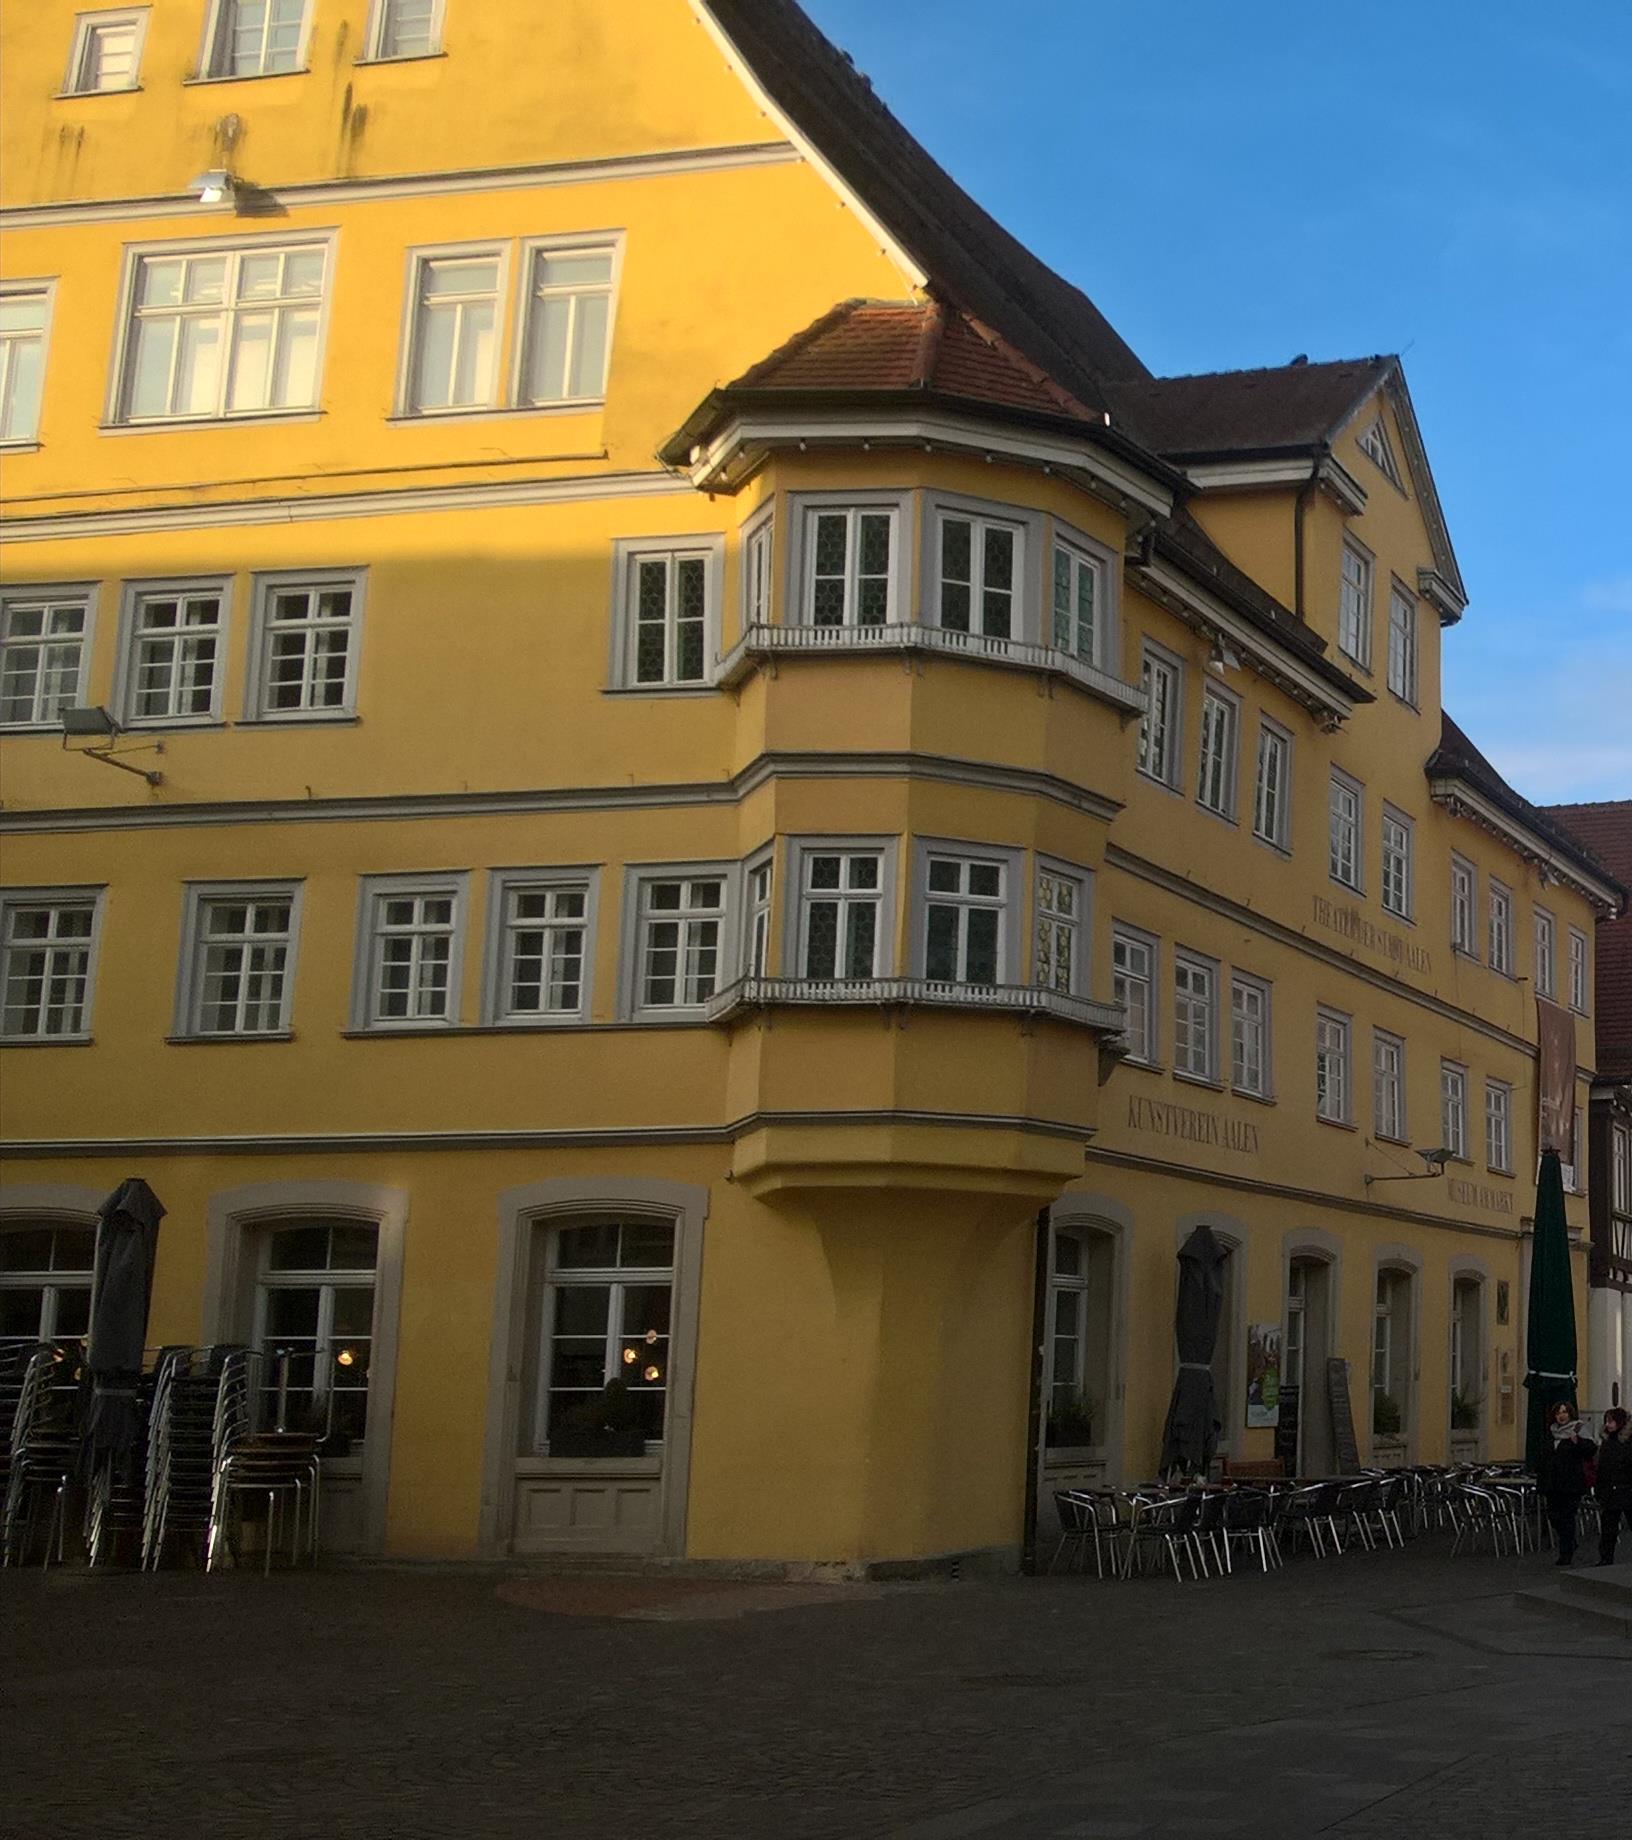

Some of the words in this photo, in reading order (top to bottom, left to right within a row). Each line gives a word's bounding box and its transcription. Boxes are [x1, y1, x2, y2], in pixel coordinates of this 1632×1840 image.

[1405, 942, 1433, 975] AALEN
[1128, 1095, 1218, 1146] KUNSTVEREIN
[1221, 1116, 1259, 1154] AALEN
